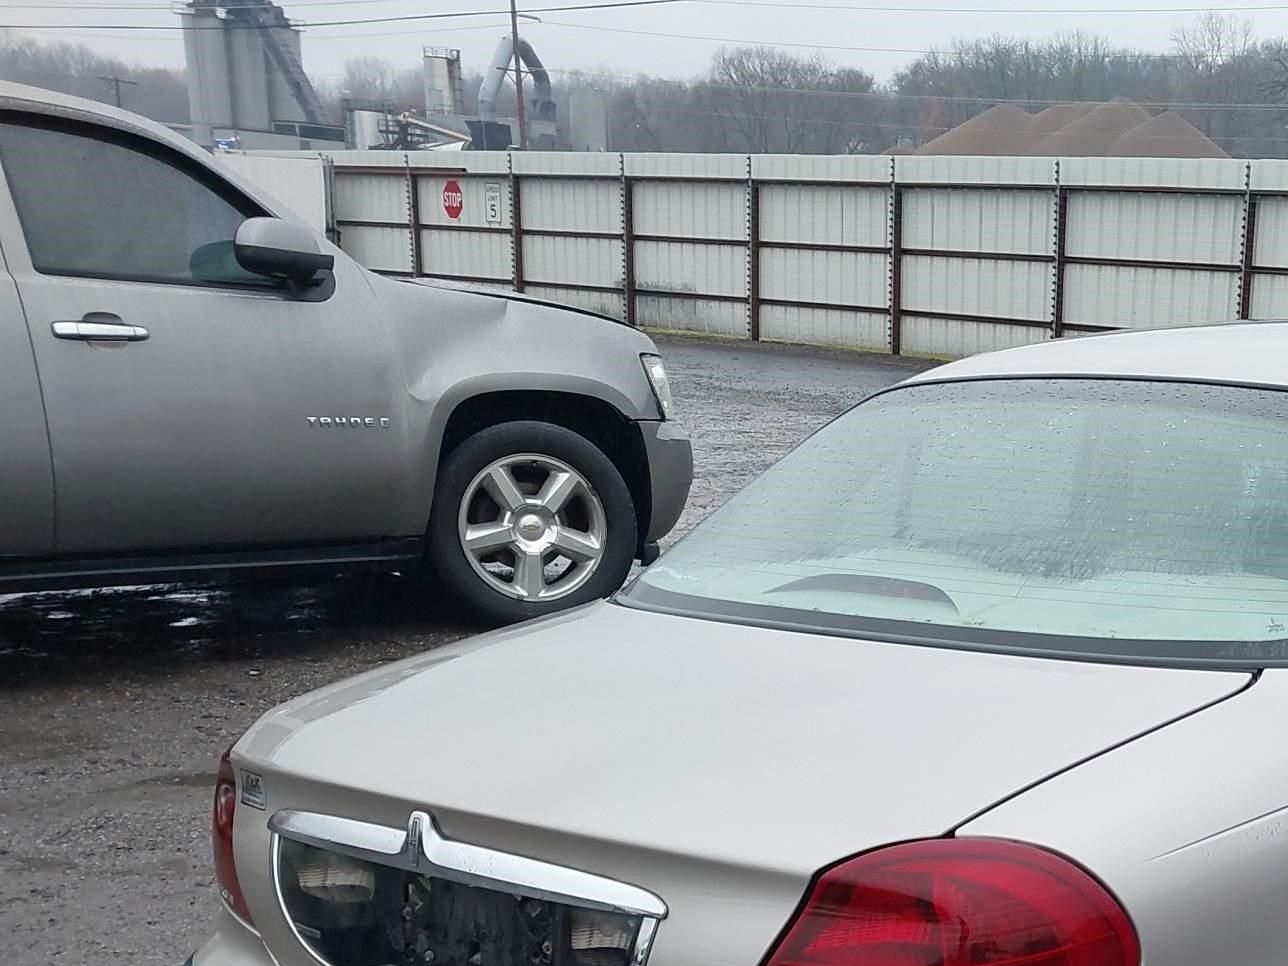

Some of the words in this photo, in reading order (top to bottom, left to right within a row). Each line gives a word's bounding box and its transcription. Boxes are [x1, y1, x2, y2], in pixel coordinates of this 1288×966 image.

[444, 192, 461, 207] STOP
[490, 204, 497, 218] 5
[306, 416, 377, 428] TAHOE
